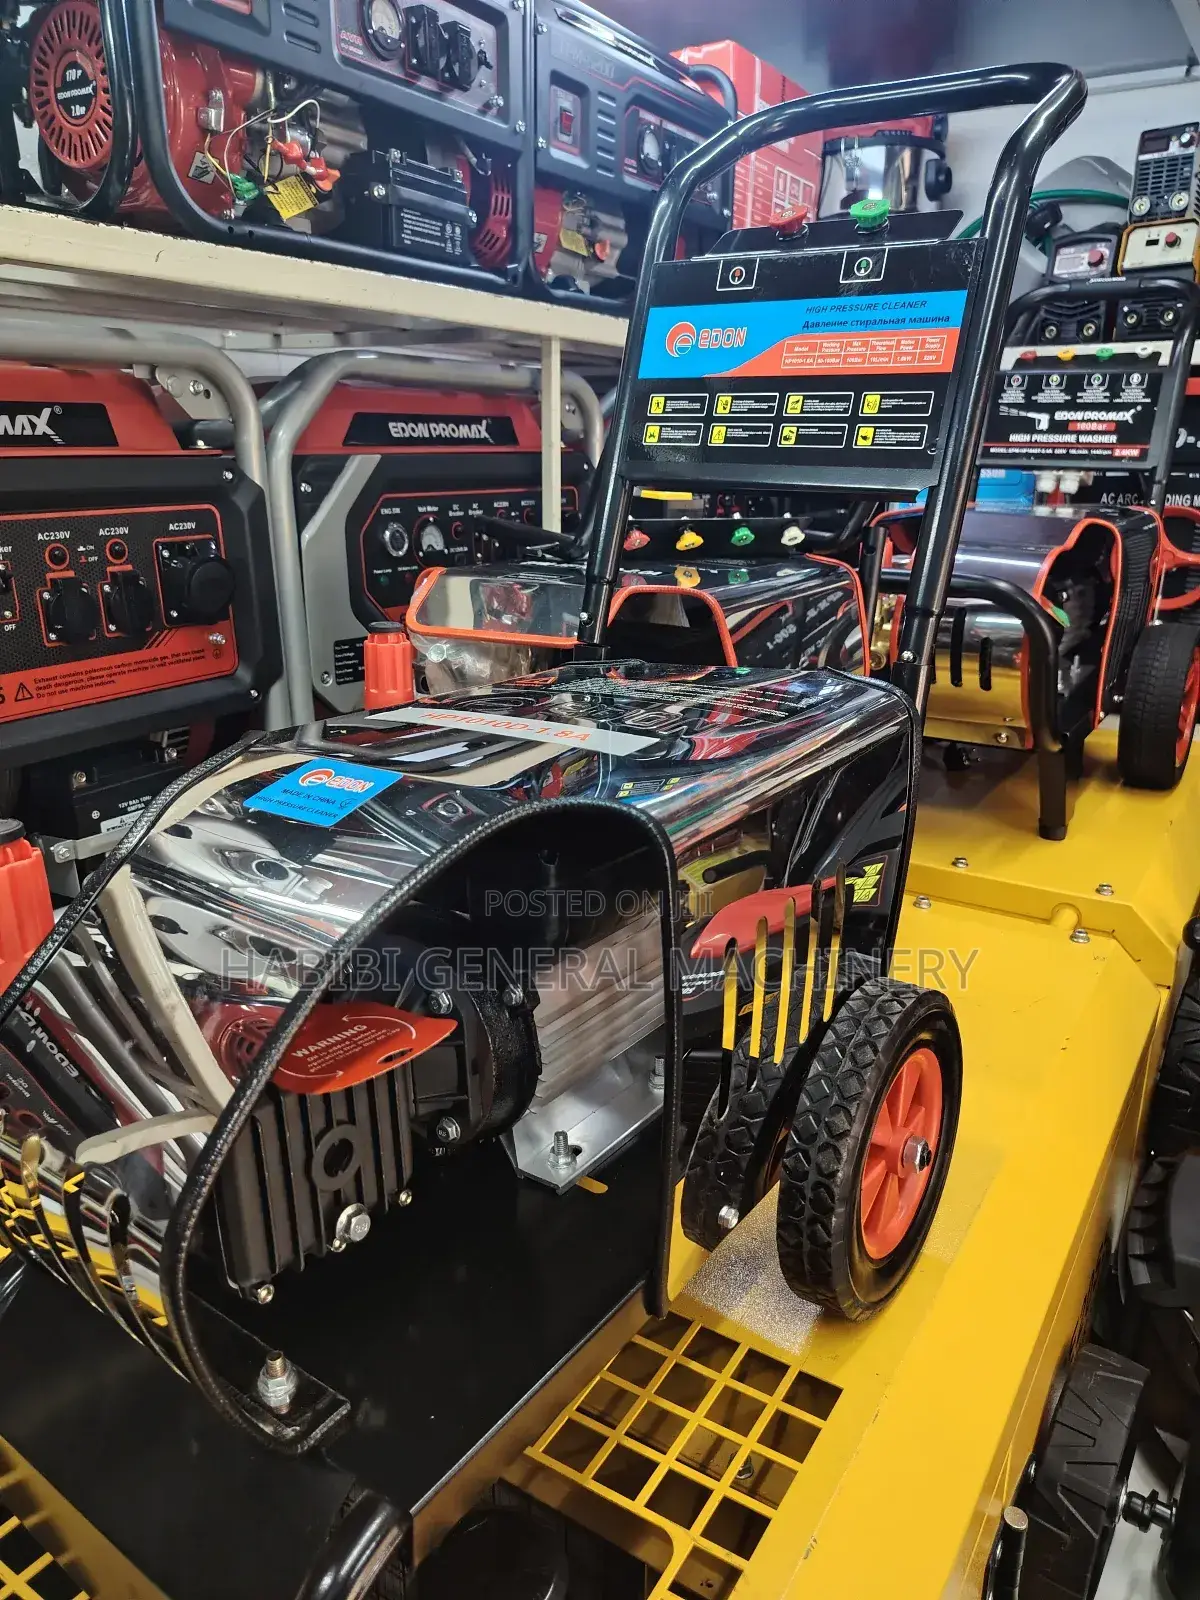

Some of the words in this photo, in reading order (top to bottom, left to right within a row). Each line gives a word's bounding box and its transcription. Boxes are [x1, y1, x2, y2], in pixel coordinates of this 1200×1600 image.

[805, 305, 828, 314] HIGH
[830, 302, 880, 313] PRESSURE
[881, 300, 928, 311] CLEANER
[802, 319, 849, 331] Давление
[850, 317, 906, 328] стиральная
[908, 315, 950, 324] машина
[1054, 411, 1083, 420] EDON
[1083, 408, 1136, 424] PROMAX
[388, 421, 430, 438] EDON
[429, 419, 493, 443] PROMAX
[1009, 433, 1031, 442] HIGH
[1031, 433, 1078, 443] PRESSURE
[1078, 434, 1118, 444] WASHER
[1101, 493, 1116, 505] AC
[1117, 492, 1139, 505] ARC
[1164, 493, 1192, 506] DING
[98, 527, 130, 537] AC230V
[168, 522, 197, 531] AC230V
[37, 531, 71, 542] AC230V
[4, 624, 17, 632] OFF
[34, 675, 58, 685] Exhaust
[60, 671, 84, 680] contains
[84, 665, 114, 675] poisonous
[134, 657, 159, 665] monoxide
[171, 651, 182, 659] that
[35, 684, 53, 692] death
[105, 670, 127, 679] operate
[127, 666, 150, 674] machine
[69, 682, 94, 692] machine
[281, 788, 302, 797] MADE
[312, 795, 337, 805] CHINA
[254, 795, 275, 803] HIGH
[274, 799, 306, 811] PRESSURE
[306, 807, 339, 819] CLEANER
[291, 1024, 368, 1058] WARNING
